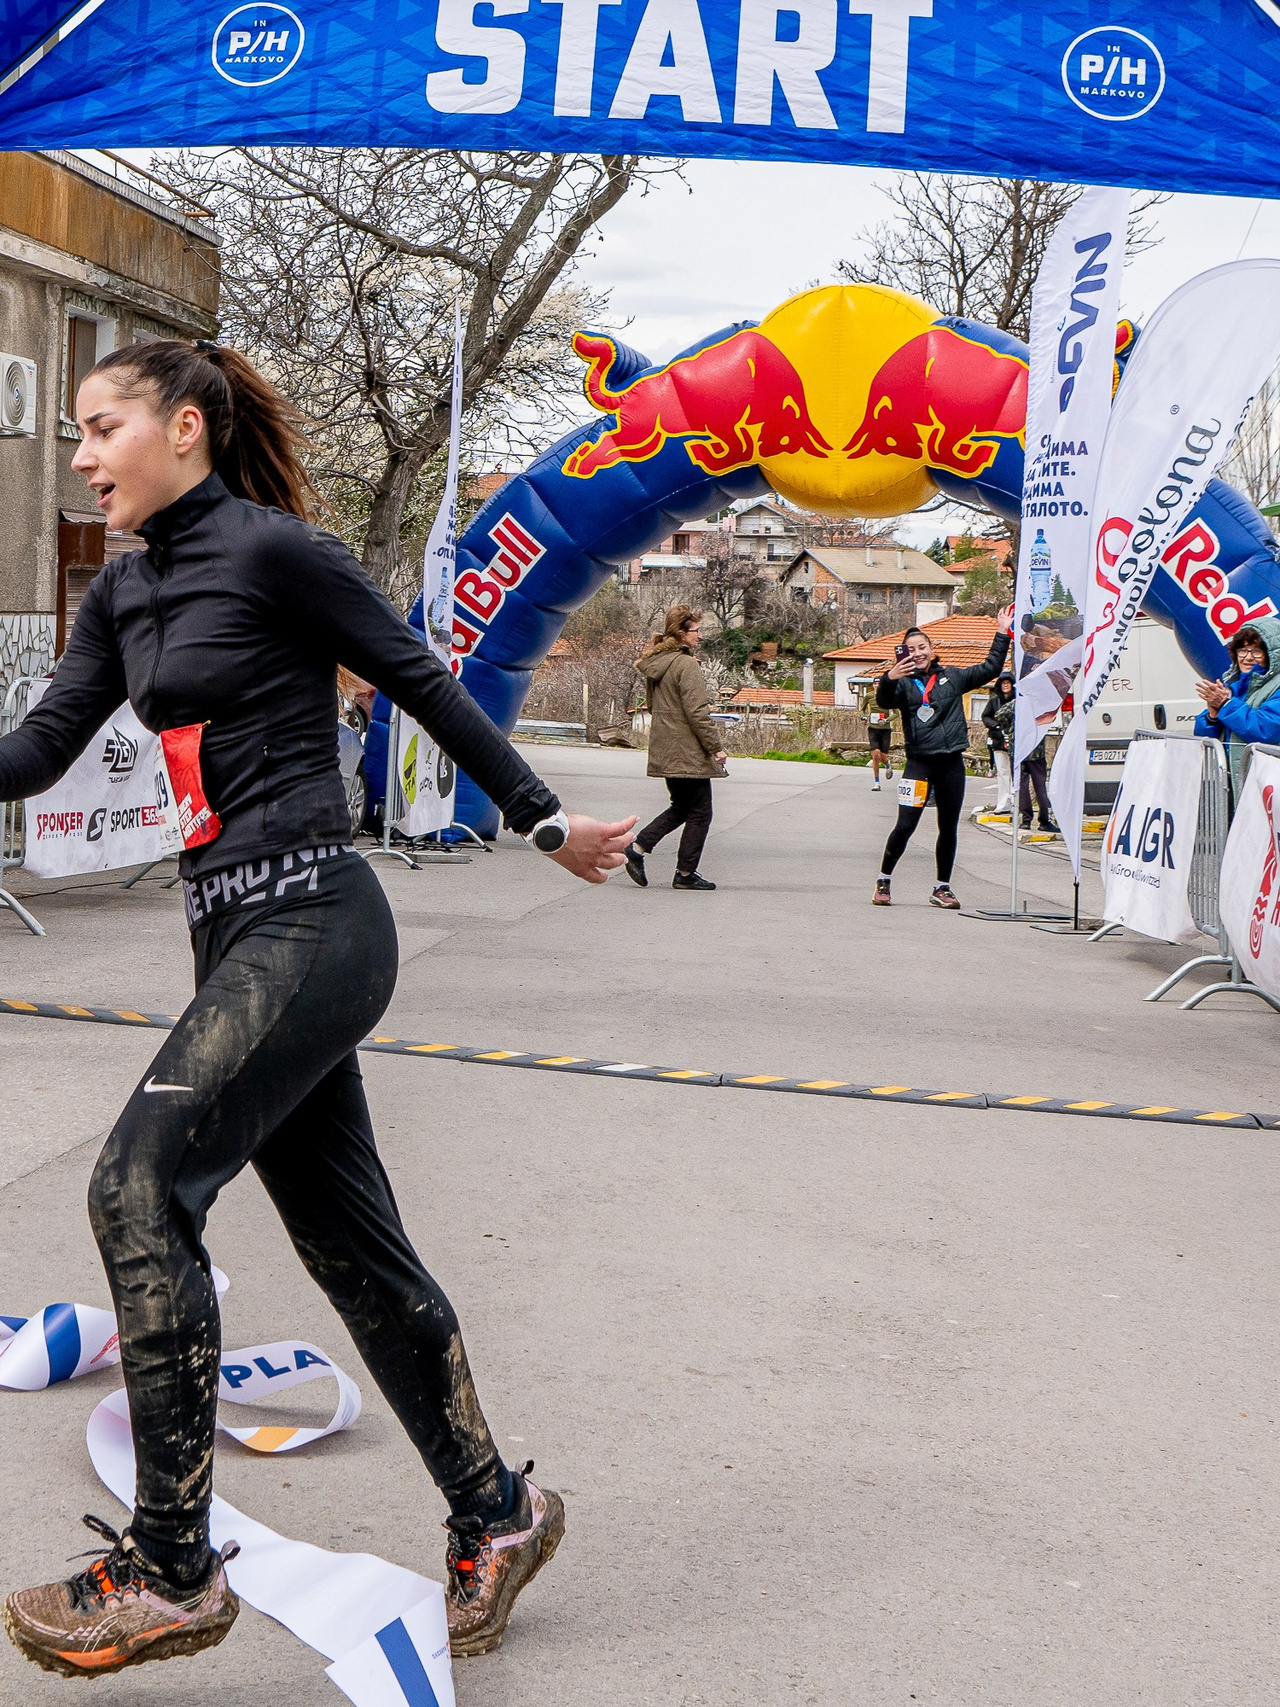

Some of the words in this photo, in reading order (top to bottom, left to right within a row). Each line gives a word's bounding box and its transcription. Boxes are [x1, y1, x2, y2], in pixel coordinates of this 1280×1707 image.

[228, 30, 290, 55] P/H
[1107, 45, 1120, 53] IN
[425, 0, 934, 134] START
[1081, 54, 1146, 86] P/H
[1080, 87, 1145, 98] MARKOVO
[454, 517, 542, 621] Bull
[1161, 522, 1273, 641] Red
[36, 811, 84, 841] SPONSER
[110, 807, 141, 833] SPORT
[220, 1349, 332, 1389] PLA
